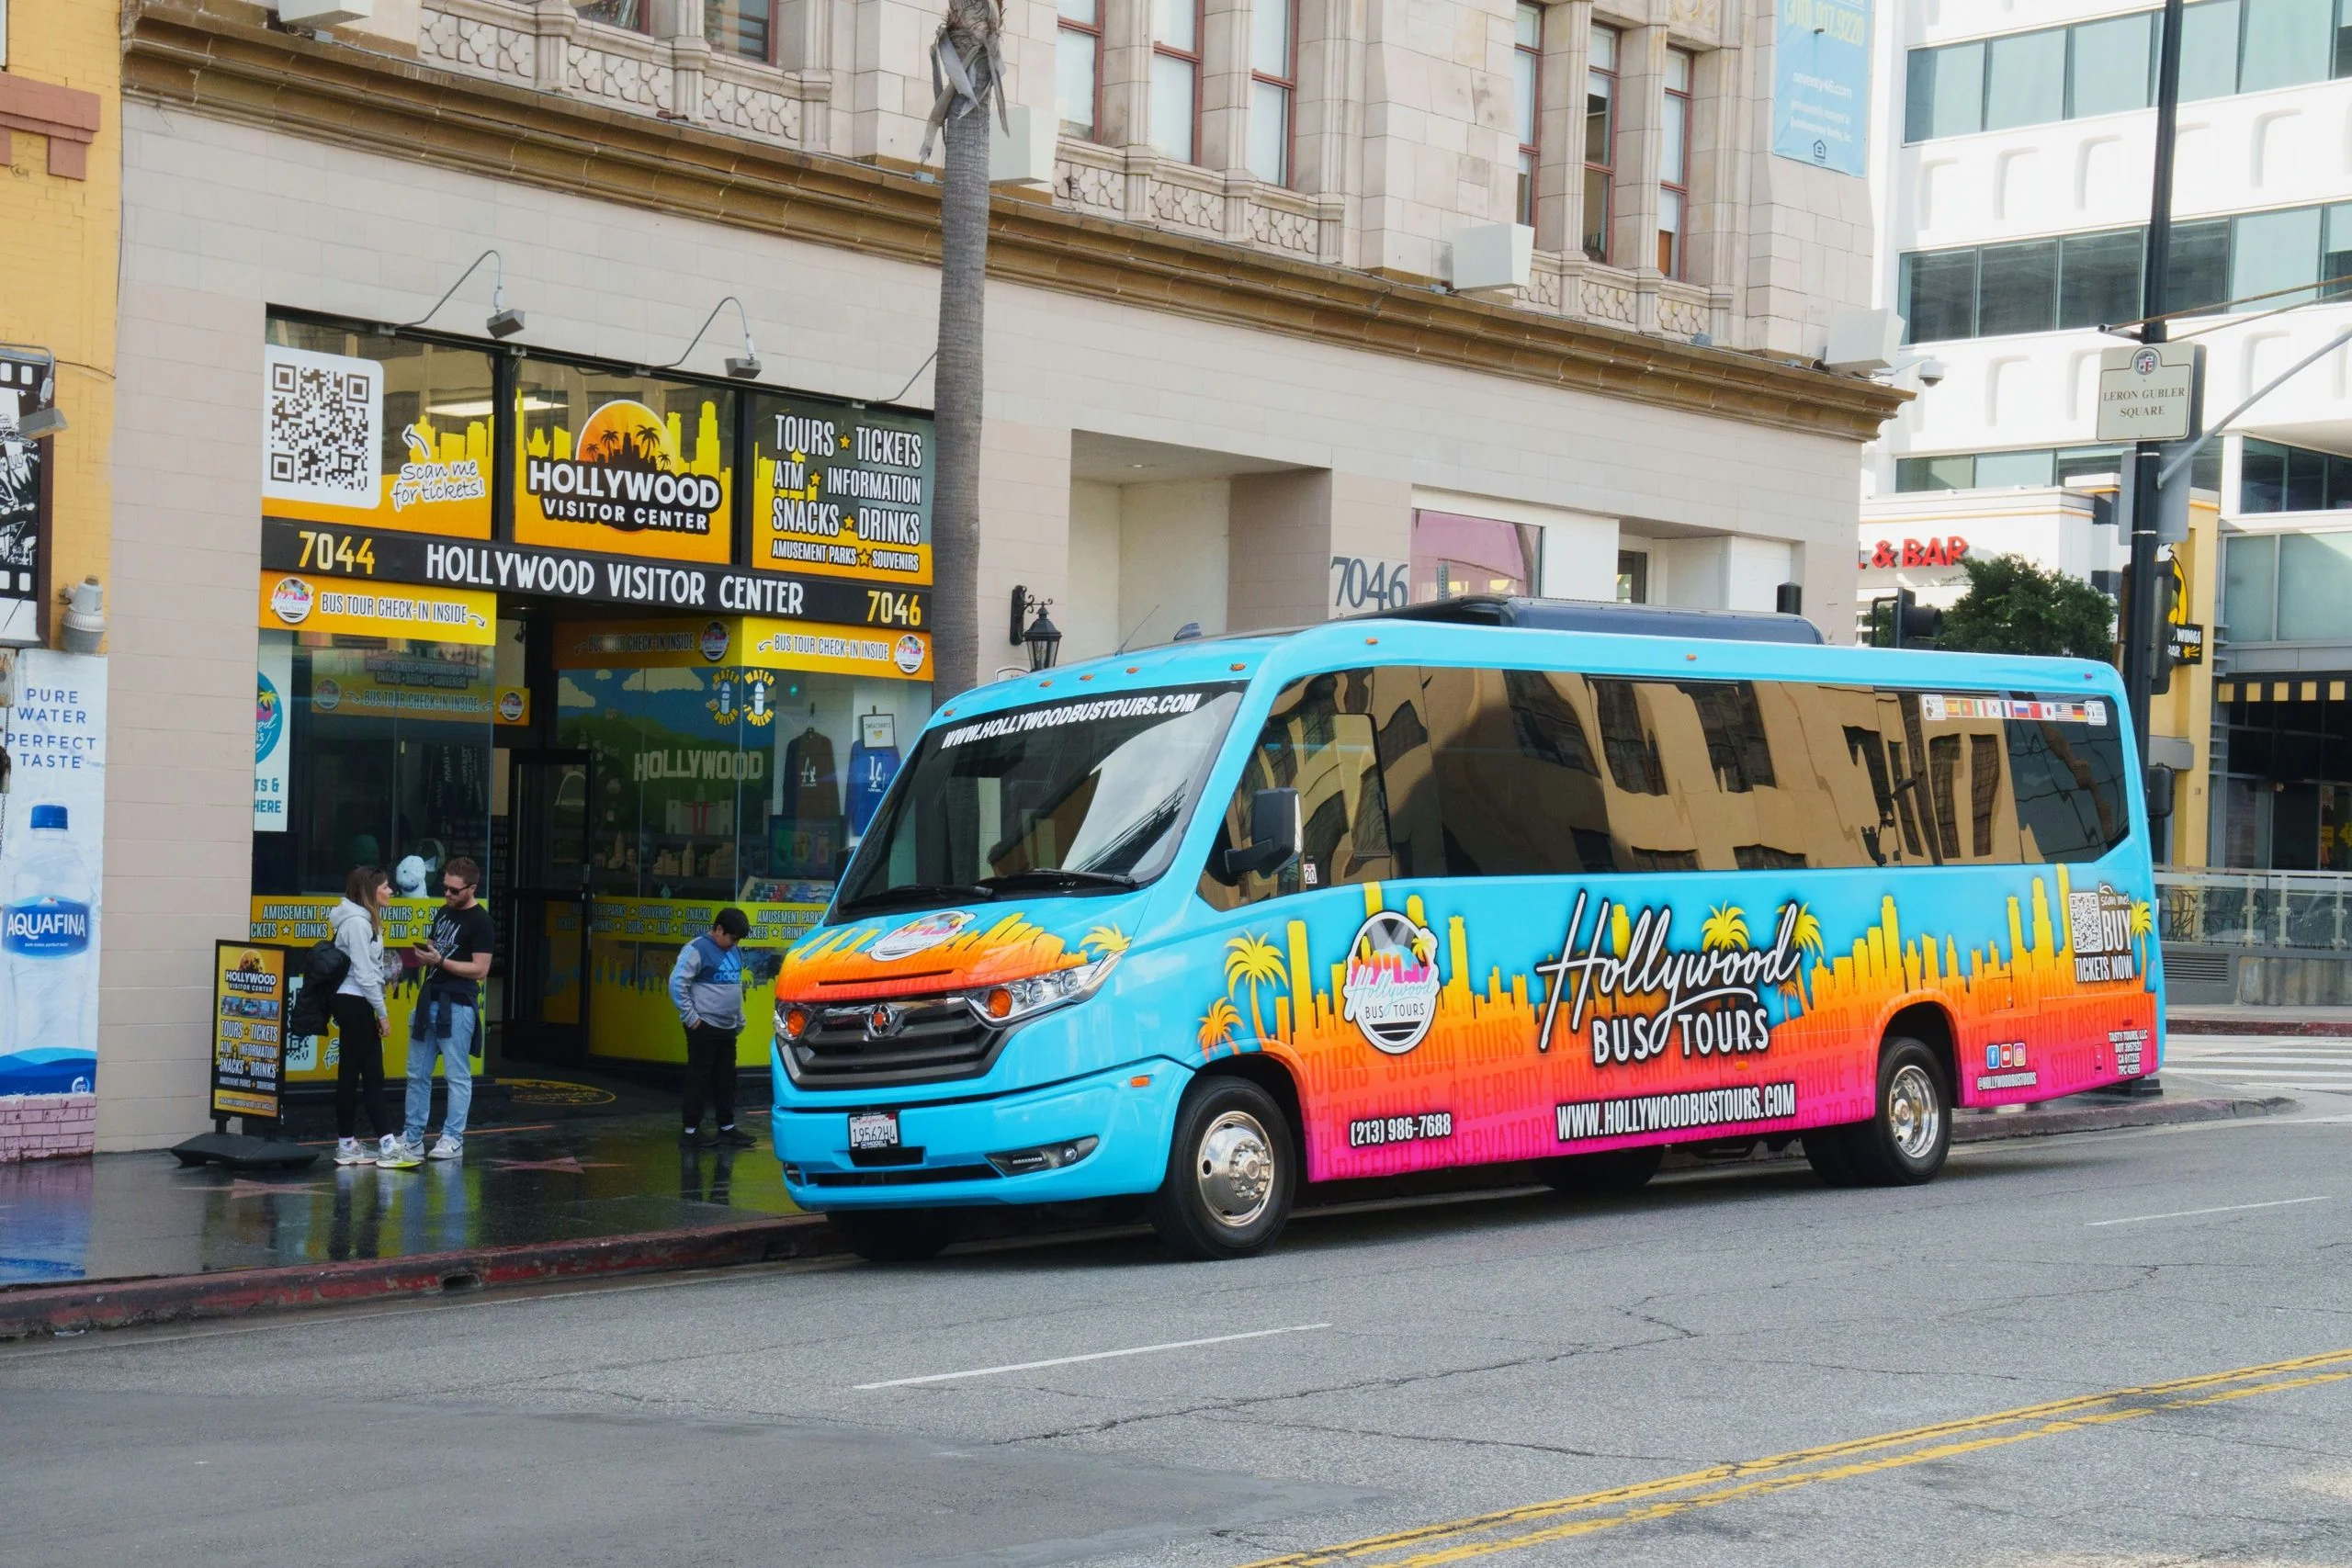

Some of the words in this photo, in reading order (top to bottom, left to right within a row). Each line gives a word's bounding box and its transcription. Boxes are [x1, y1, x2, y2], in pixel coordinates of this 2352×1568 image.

[2103, 390, 2139, 401] LERON
[2142, 387, 2185, 399] GUBLER
[2120, 405, 2165, 418] SQUARE
[775, 414, 835, 457] TOURS
[855, 426, 922, 468] TICKETS
[401, 463, 447, 481] Scan
[453, 461, 478, 477] me
[529, 460, 720, 509] HOLLYWOOD
[773, 460, 804, 491] ATM
[827, 468, 922, 504] INFORMATION
[391, 485, 417, 512] for
[421, 477, 485, 502] tickets!
[543, 498, 626, 523] VISITOR
[634, 508, 707, 531] CENTER
[772, 498, 840, 536] SNACKS
[858, 508, 920, 547] DRINKS
[298, 530, 376, 575] 7044
[771, 540, 827, 562] AMUSEMENT
[829, 544, 856, 567] PARKS
[872, 550, 920, 572] SOUVENIRS
[1871, 539, 1898, 568] &
[1902, 536, 1969, 568] BAR
[425, 543, 595, 595] HOLLYWOOD
[607, 563, 707, 606] VISITOR
[718, 575, 804, 616] CENTER
[1330, 556, 1408, 611] 7046
[321, 593, 344, 614] BUS
[346, 595, 374, 616] TOUR
[378, 598, 429, 621] CHECK-IN
[433, 603, 468, 625] INSIDE
[866, 590, 922, 626] 7046
[668, 632, 695, 650] INSIDE
[775, 634, 791, 651] BUS
[792, 636, 816, 654] TOUR
[818, 637, 859, 658] CHECK-IN
[861, 640, 888, 660] INSIDE
[743, 670, 775, 686] WATER
[27, 688, 78, 705] PURE
[364, 690, 381, 706] BUS
[408, 693, 448, 709] CHECK-IN
[451, 694, 479, 711] INSIDE
[17, 707, 86, 724] WATER
[747, 708, 775, 727] DOLLAR
[941, 693, 1202, 750] WWW.HOLLYWOODBUSTOURS.COM
[6, 732, 96, 750] PERFECT
[19, 753, 81, 769] TASTE
[633, 749, 763, 782] HOLLYWOOD
[1305, 869, 1316, 883] 20
[263, 904, 320, 921] AMUSEMENT
[379, 906, 413, 921] VENIRS
[639, 904, 673, 919] SOUVENIRS
[685, 907, 711, 922] SNACKS
[757, 909, 799, 924] AMUSEMENT
[6, 912, 86, 940] AQUAFINA
[250, 922, 277, 939] CKETS
[294, 923, 328, 939] DRINKS
[389, 924, 407, 939] ATM
[625, 920, 644, 934] TOURS
[681, 922, 715, 938] INFORMAT
[747, 925, 769, 940] CKETS
[2101, 909, 2132, 952] BUY
[225, 970, 277, 986] HOLLYWOOD
[1536, 888, 1804, 1053] Hollywood
[2075, 956, 2109, 982] TICKETS
[2111, 954, 2133, 980] NOW
[229, 983, 250, 992] VISITOR
[252, 985, 273, 993] CENTER
[1347, 966, 1436, 1016] Hollywood
[1365, 1006, 1384, 1019] BUS
[1394, 1002, 1425, 1017] TOURS
[220, 1020, 243, 1038] TOURS
[250, 1023, 278, 1042] TICKETS
[1592, 1017, 1649, 1064] BUS
[1678, 1008, 1770, 1055] TOURS
[1770, 1007, 1850, 1058] OLLYWOOD
[2109, 1031, 2122, 1042] TASTY
[2140, 1029, 2148, 1040] LLC
[220, 1040, 232, 1054] ATM
[238, 1043, 277, 1059] INFORMATION
[2115, 1043, 2124, 1054] DOT
[219, 1057, 244, 1075] SNACKS
[250, 1062, 277, 1078] DRINKS
[2118, 1054, 2124, 1065] CA
[1977, 1071, 2037, 1091] @HOLLYWOODBUSTOURS
[1556, 1083, 1796, 1140] WWW.HOLLYWOODBUSTOURS.COM
[853, 1124, 896, 1145] 19562H4
[1351, 1121, 1385, 1146] (213)
[1387, 1112, 1452, 1143] 986-7688
